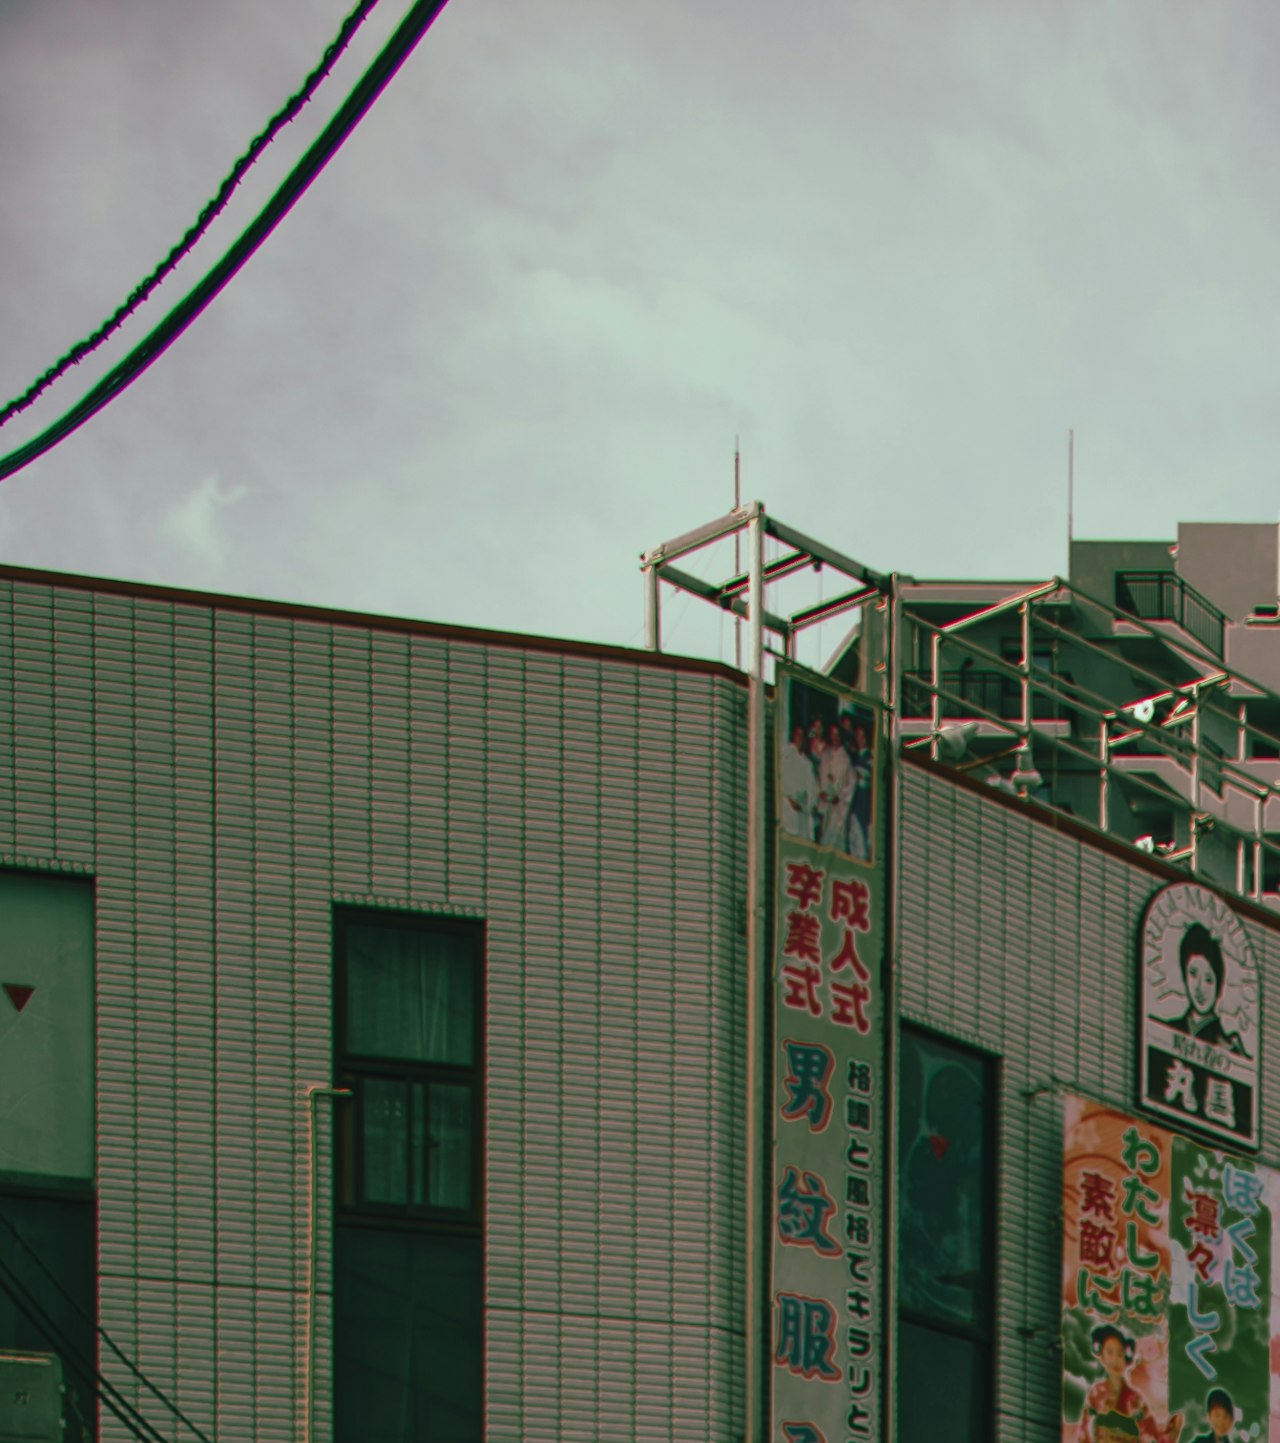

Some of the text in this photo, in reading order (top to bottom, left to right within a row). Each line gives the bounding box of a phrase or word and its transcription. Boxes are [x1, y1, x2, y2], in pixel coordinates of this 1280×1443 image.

[780, 860, 825, 1018] 卒業式
[829, 878, 871, 1034] 成人式
[1077, 1171, 1117, 1316] 素敵に
[1121, 1127, 1160, 1317] わたしは
[1224, 1165, 1263, 1310] ぼくは
